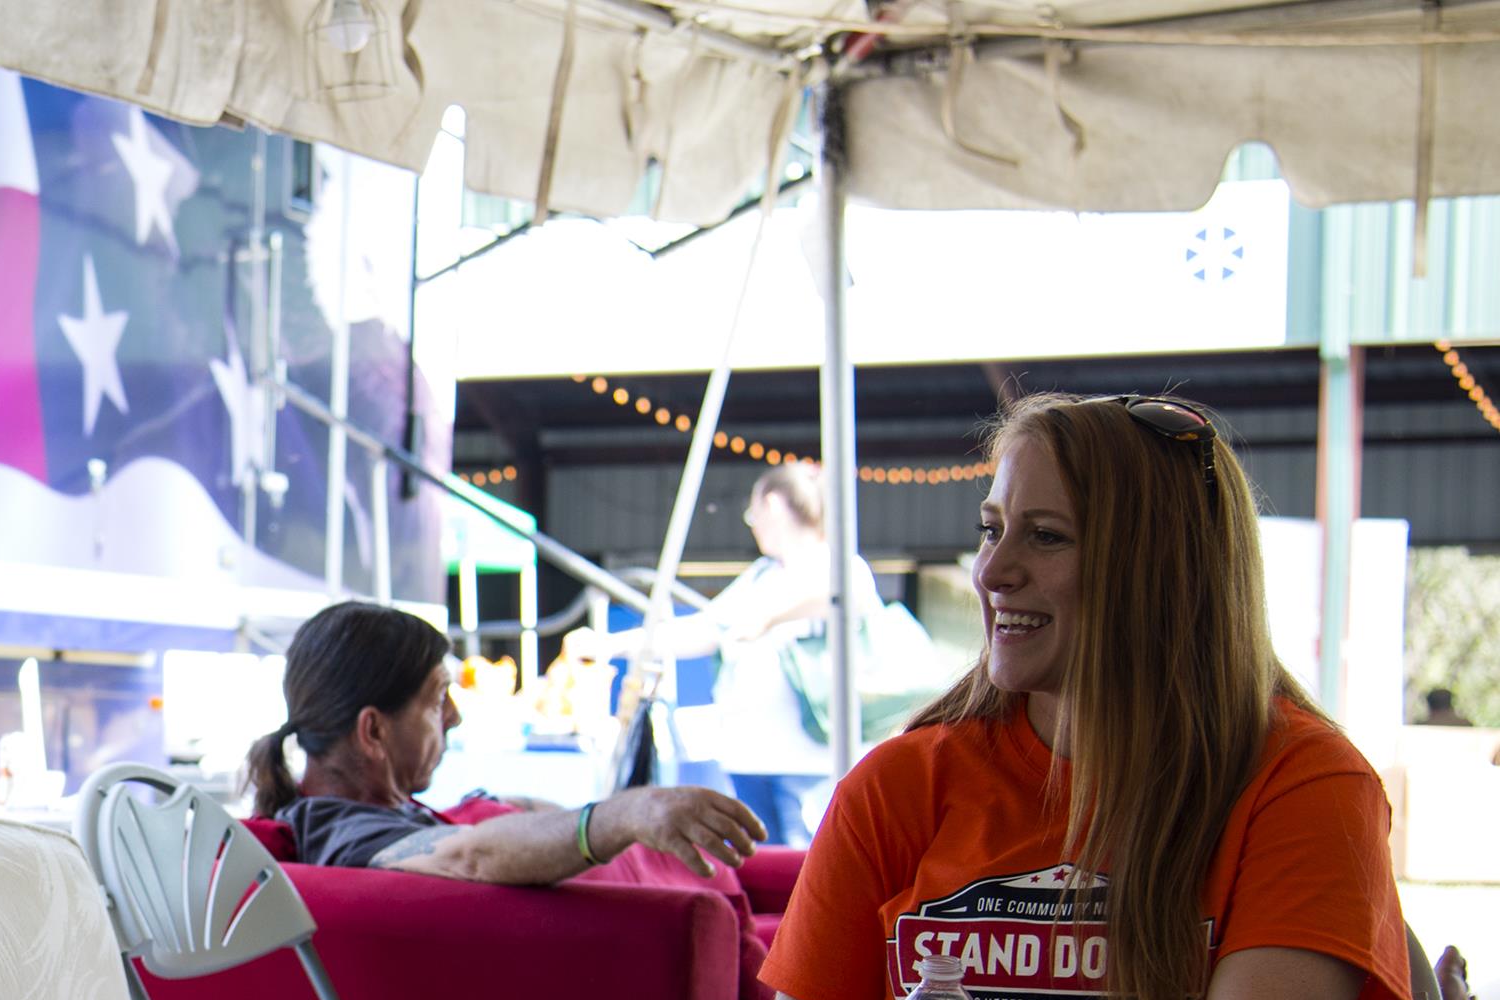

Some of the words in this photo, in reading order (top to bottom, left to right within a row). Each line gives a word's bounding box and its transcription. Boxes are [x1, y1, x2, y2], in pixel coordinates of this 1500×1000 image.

[976, 897, 1004, 912] ONE
[1006, 900, 1091, 917] COMMUNIY
[911, 930, 1042, 978] STAND
